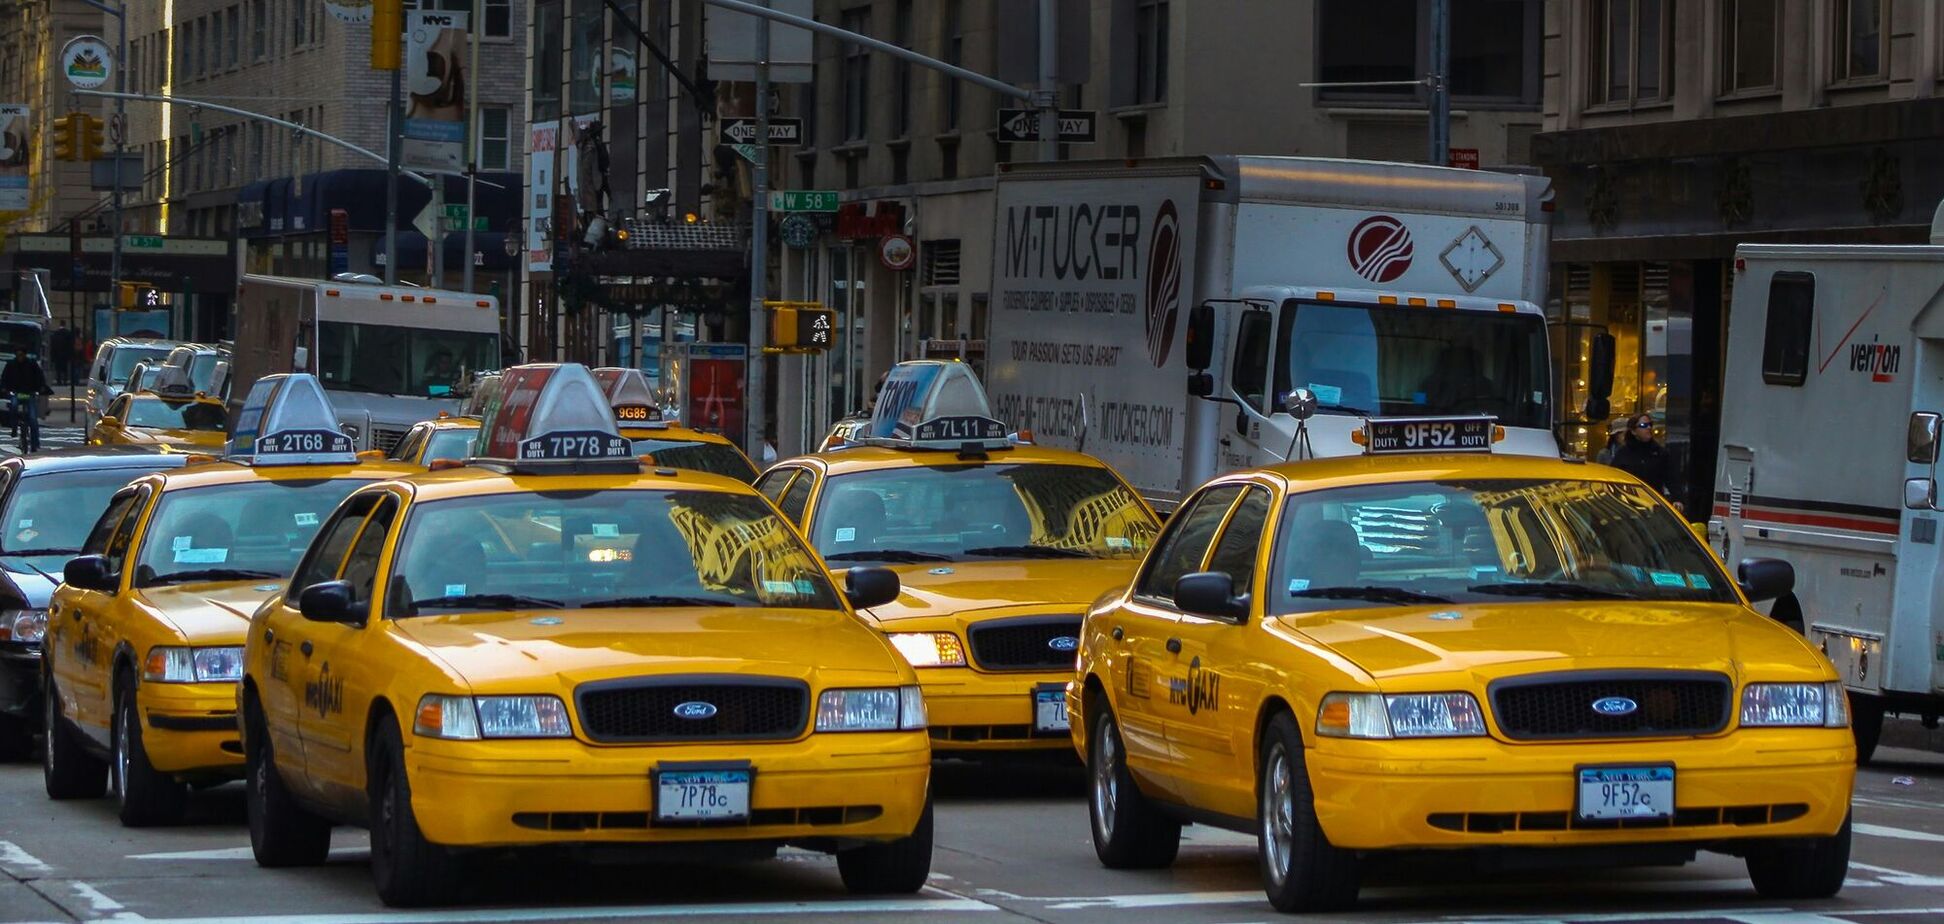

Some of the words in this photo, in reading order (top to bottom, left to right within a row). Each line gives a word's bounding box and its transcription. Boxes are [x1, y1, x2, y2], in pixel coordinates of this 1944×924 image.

[336, 12, 368, 23] CHILE
[422, 15, 452, 26] NYC
[1, 107, 21, 115] NYC
[732, 126, 754, 138] ONE
[768, 126, 791, 138] WAY
[1013, 120, 1040, 133] ONE
[785, 193, 796, 209] W
[805, 193, 823, 209] 58
[1029, 341, 1060, 364] PASSION
[1062, 344, 1081, 365] SETS
[1082, 345, 1094, 366] US
[1849, 333, 1900, 382] verizon
[878, 380, 918, 418] TOKYO
[619, 407, 647, 419] 9G85
[941, 420, 979, 437] 7L11
[1378, 426, 1395, 435] OFF
[1465, 423, 1482, 432] OFF
[1404, 423, 1456, 447] 9F52
[283, 434, 323, 451] 2T68
[529, 441, 542, 450] OFF
[550, 436, 600, 457] 7P78
[610, 438, 622, 447] OFF
[1374, 438, 1399, 448] DUTY
[1461, 436, 1485, 446] DUTY
[263, 444, 279, 452] DUTY
[607, 447, 626, 456] DUTY
[527, 450, 545, 458] DUTY
